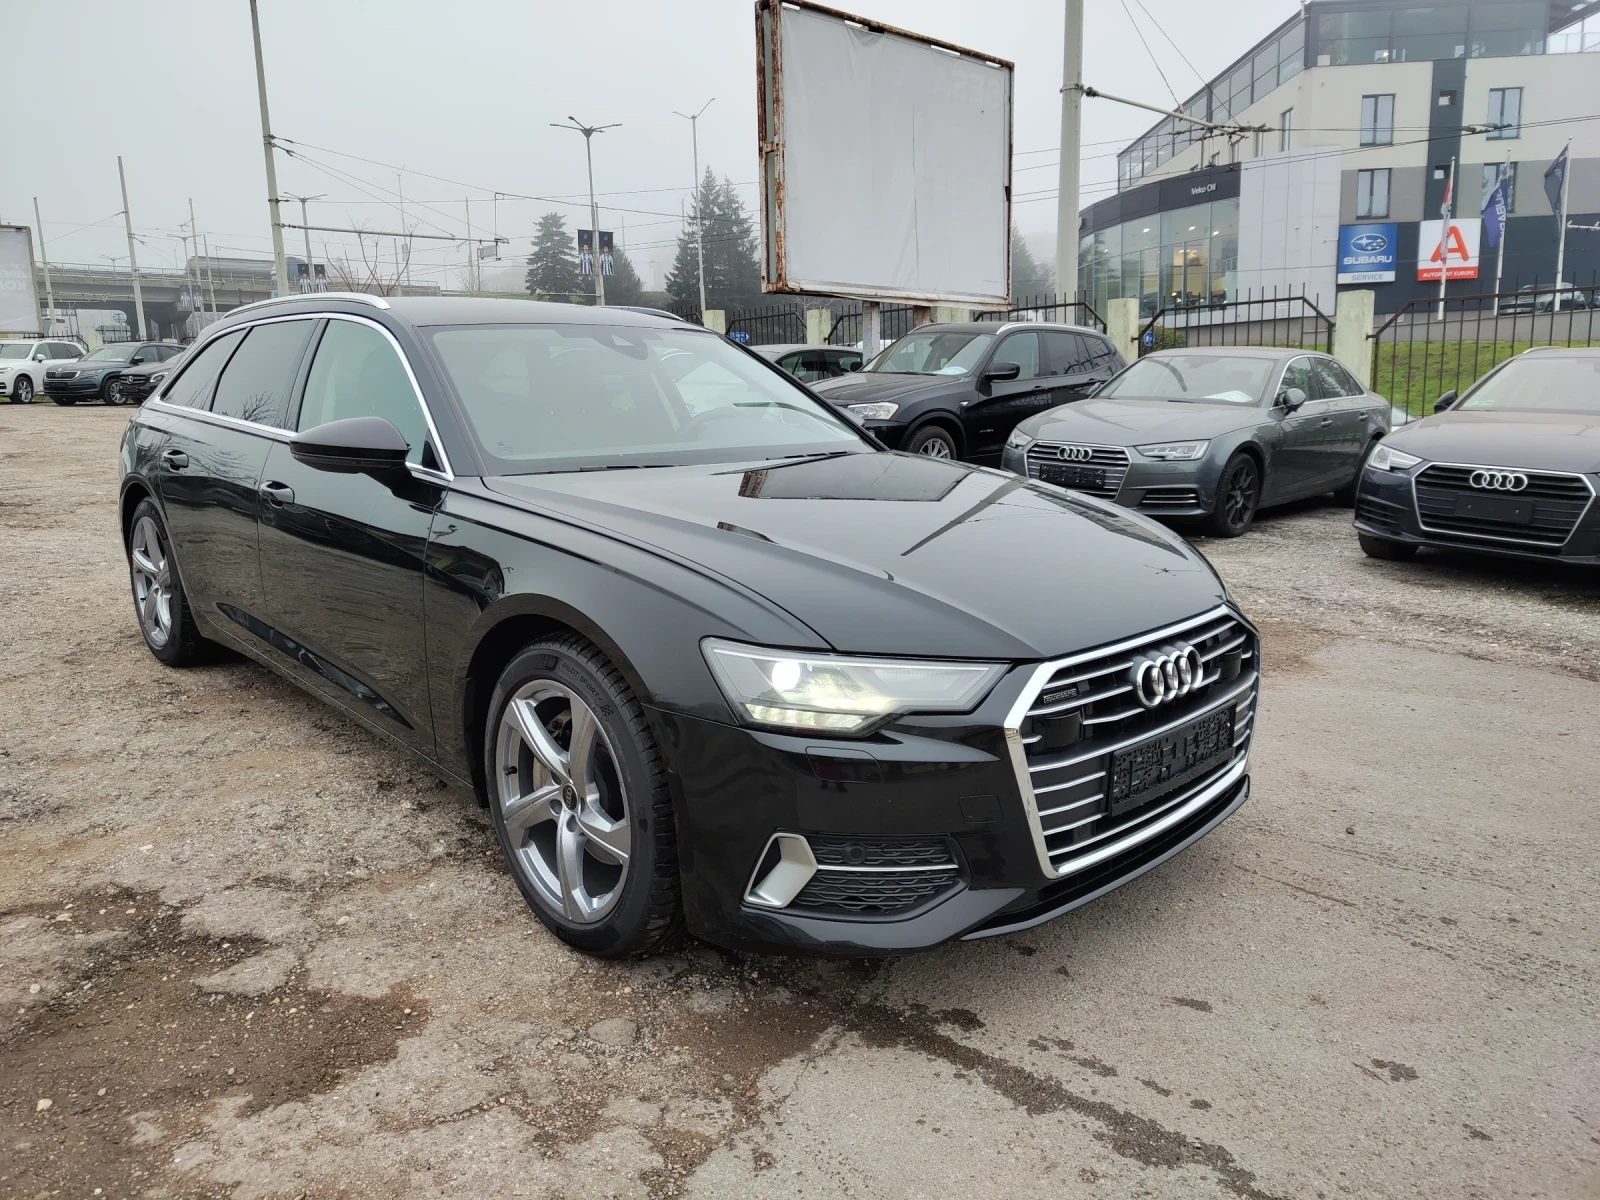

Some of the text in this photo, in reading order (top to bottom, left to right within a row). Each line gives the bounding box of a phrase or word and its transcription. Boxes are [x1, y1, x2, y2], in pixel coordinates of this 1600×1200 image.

[1191, 186, 1206, 195] Veko
[1343, 255, 1393, 265] SUBARU
[1351, 273, 1384, 281] SERVICE
[562, 662, 579, 677] PILOT
[579, 675, 600, 698] SPORT
